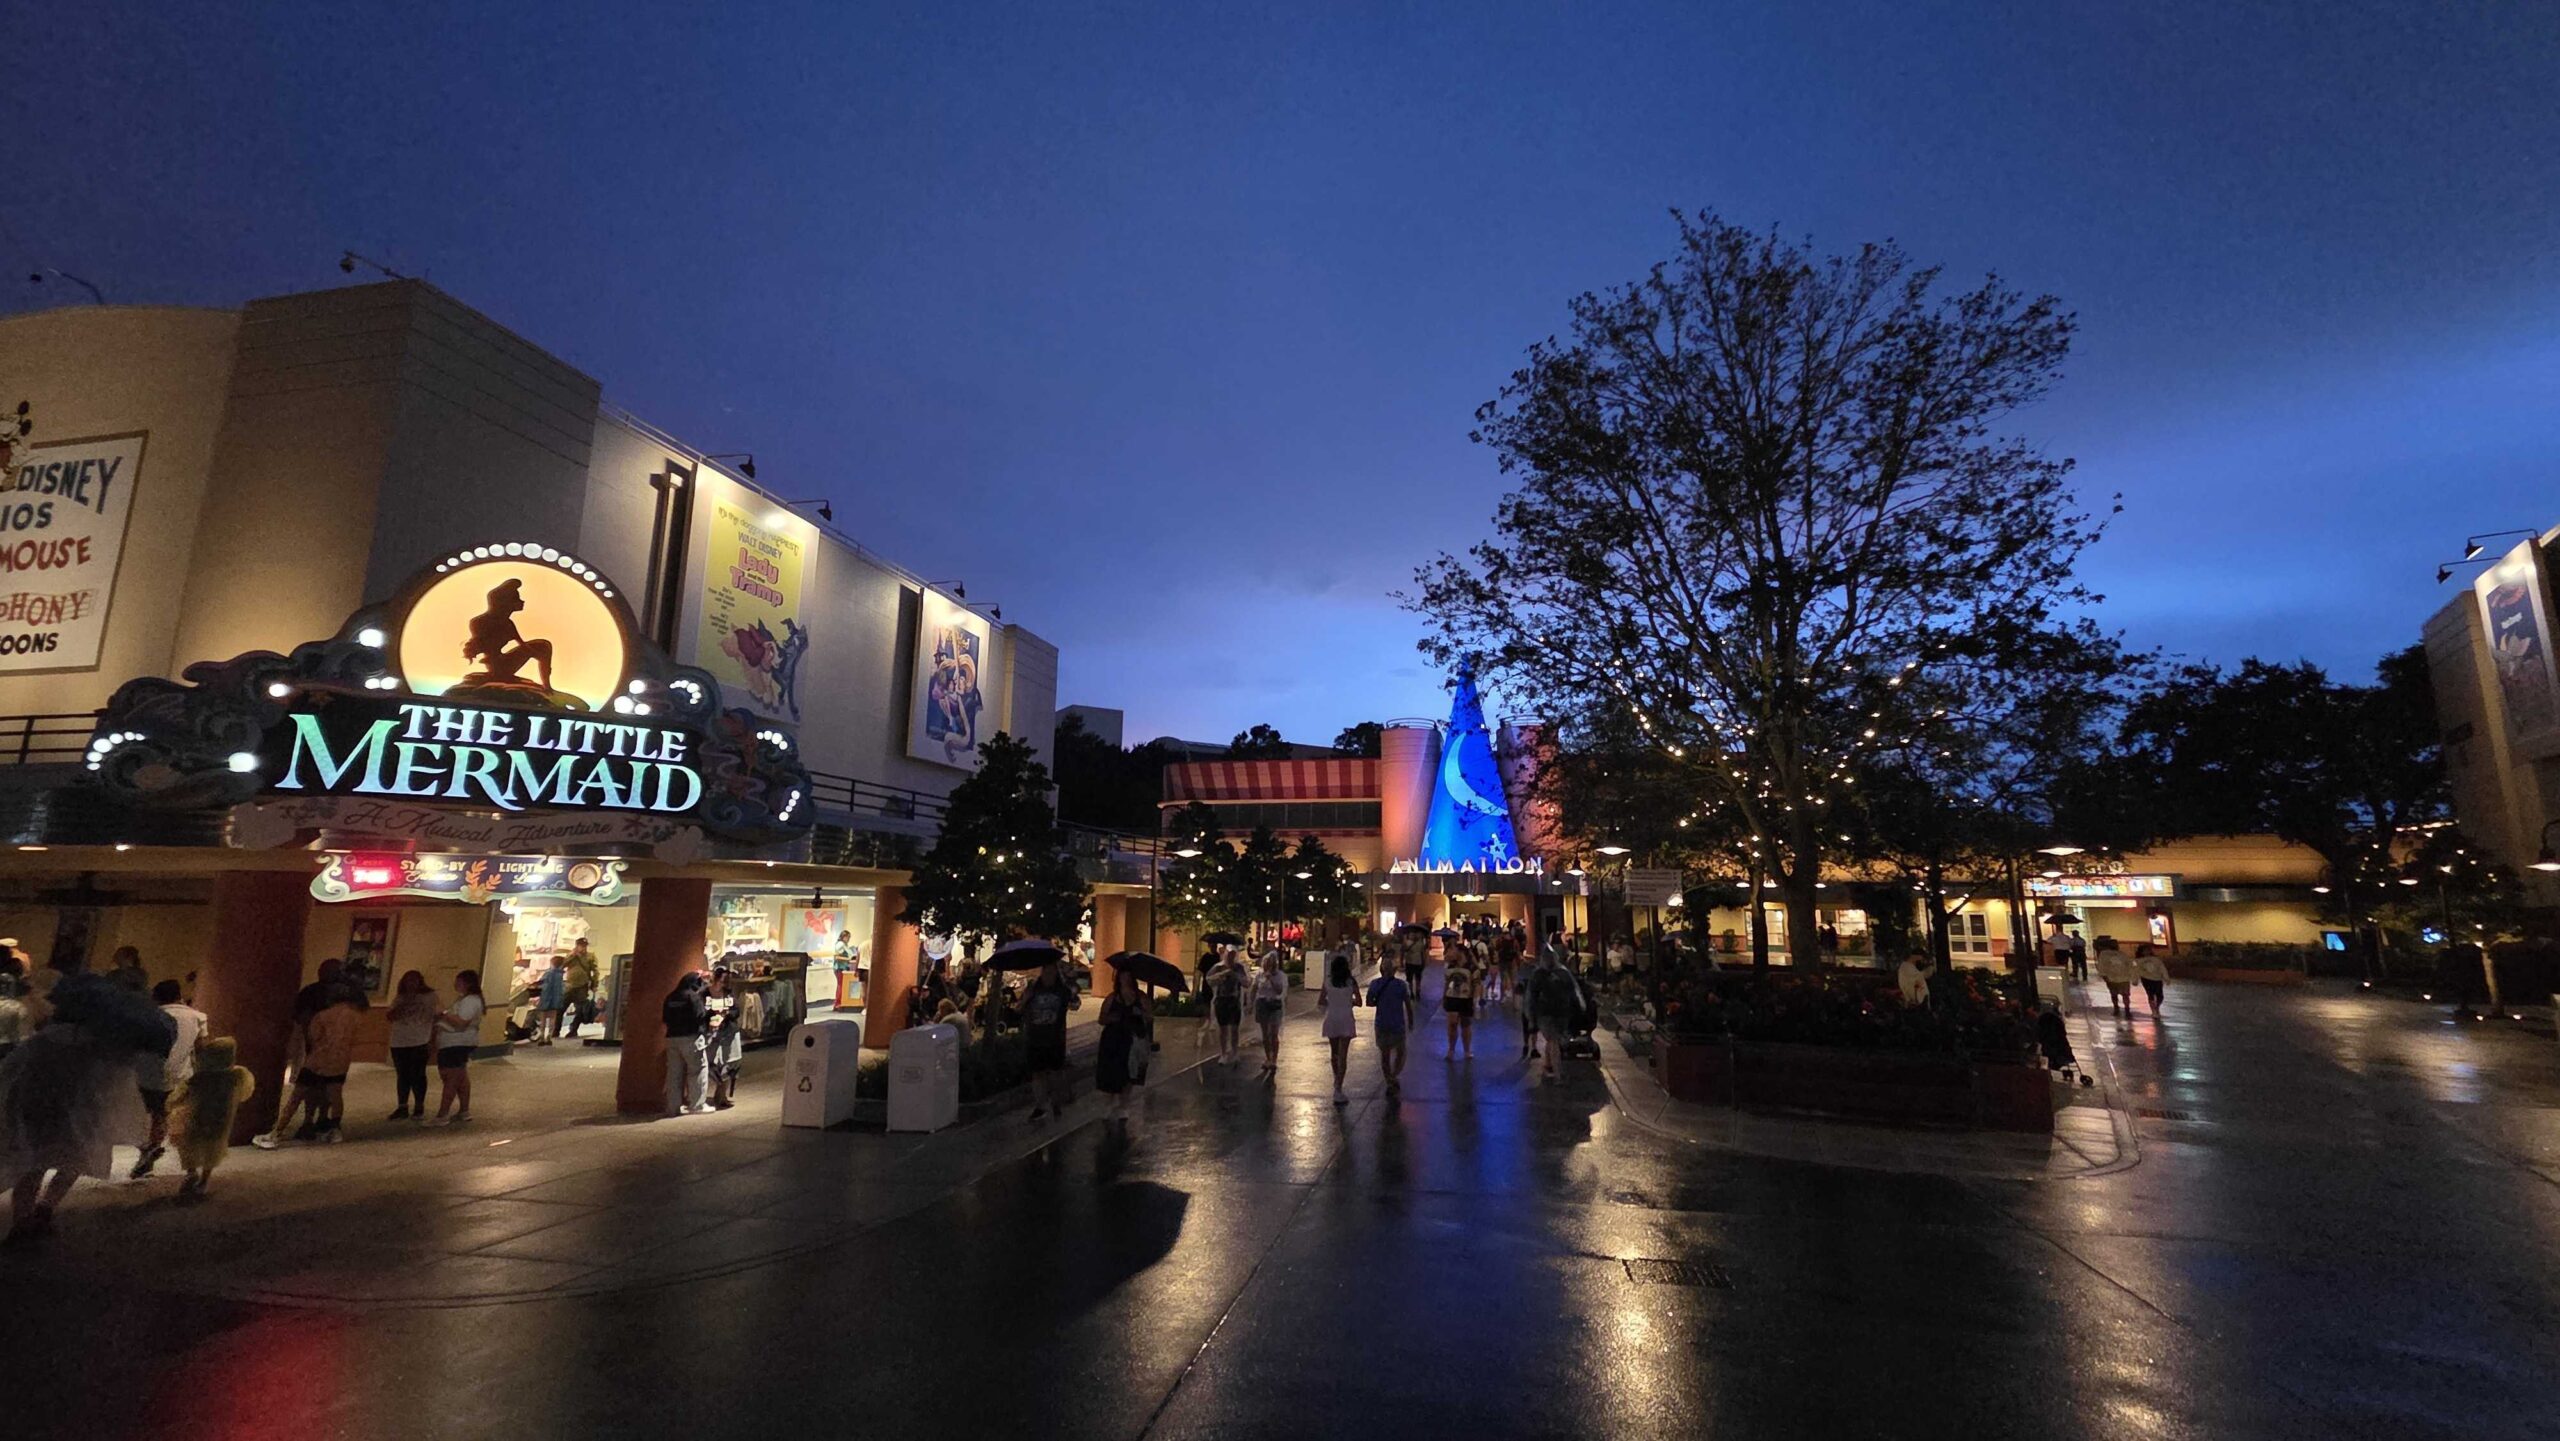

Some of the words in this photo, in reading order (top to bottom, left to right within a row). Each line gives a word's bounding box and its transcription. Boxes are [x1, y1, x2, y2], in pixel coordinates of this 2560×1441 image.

[17, 456, 122, 515] DISNEY
[738, 531, 757, 548] WALT
[758, 541, 782, 560] DISNEY
[739, 547, 779, 584] Lady
[730, 565, 784, 607] Tramp
[0, 632, 59, 655] OONS
[398, 704, 515, 746] THE
[523, 715, 689, 762] LITTLE
[274, 713, 702, 812] MERMAID
[343, 801, 390, 826] A
[384, 809, 493, 842] Musical
[497, 820, 614, 849] Adventure
[400, 859, 466, 872] STAD-BY
[499, 862, 564, 874] LIGHTG
[1389, 856, 1542, 874] ANIMATION
